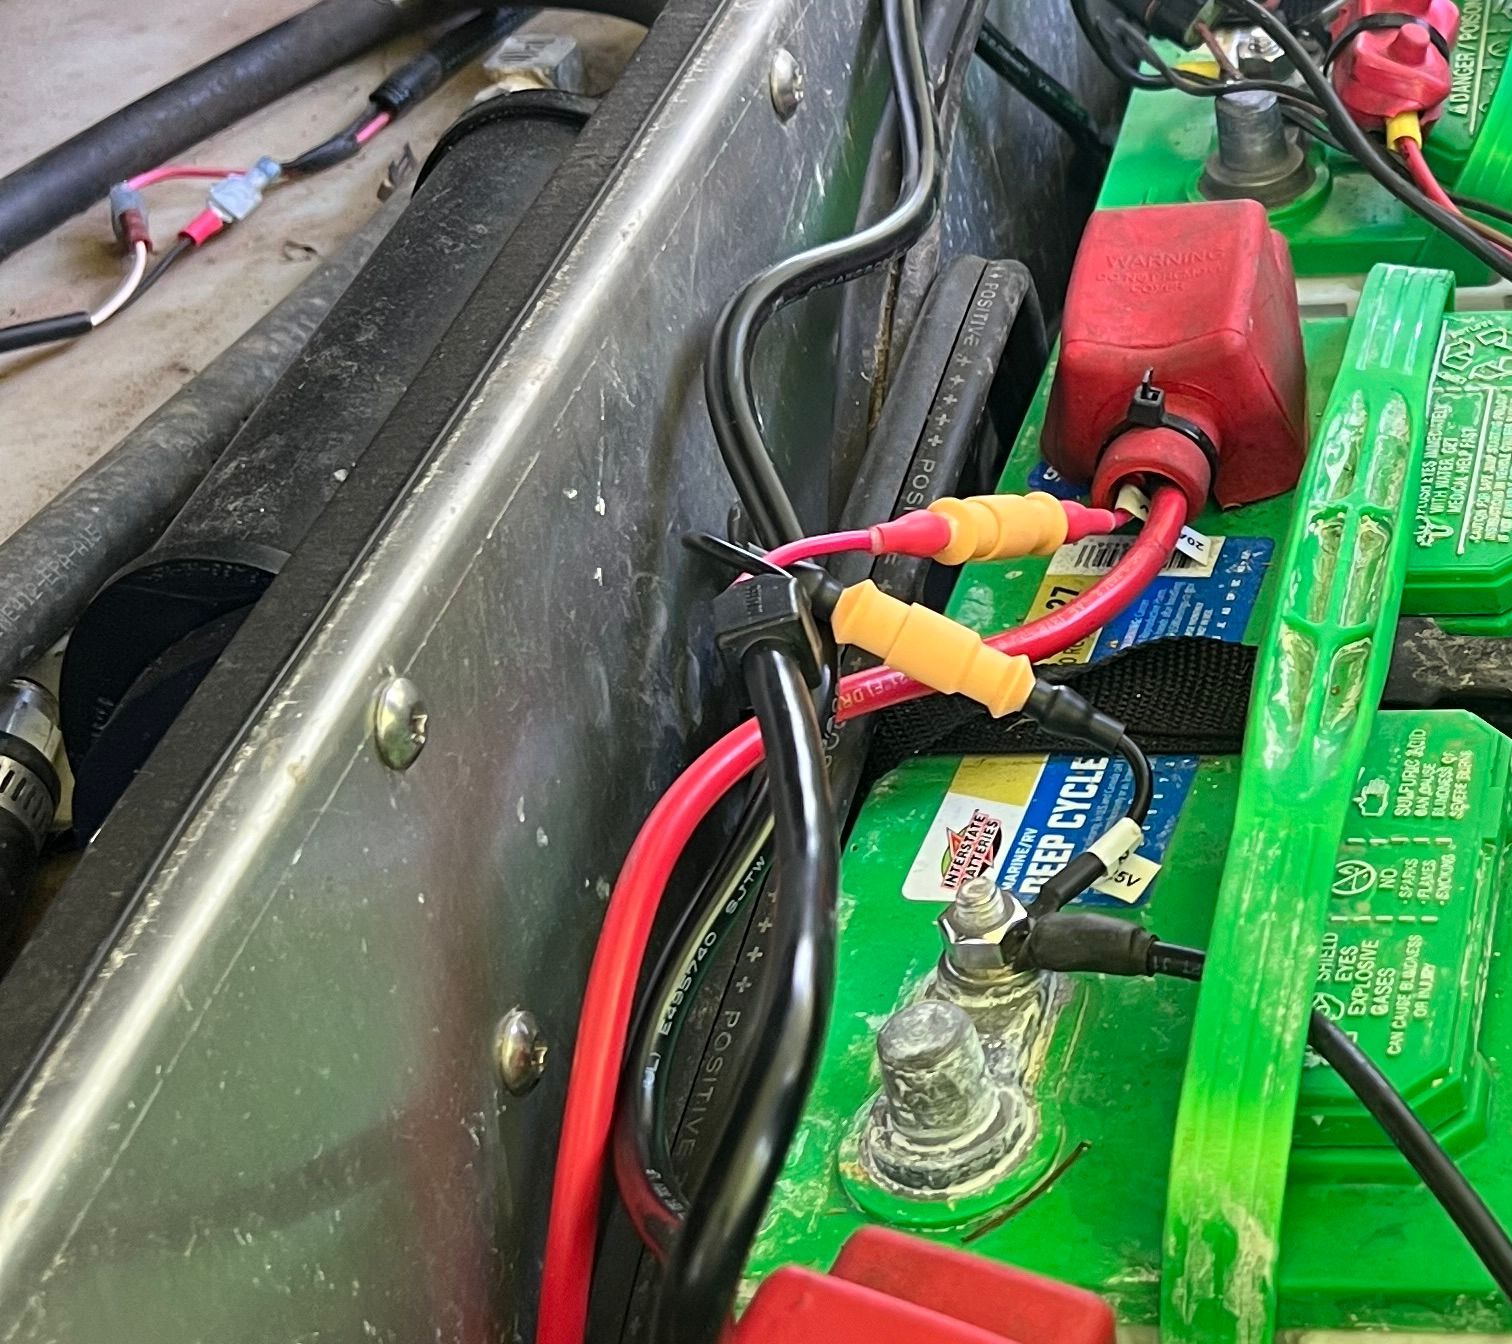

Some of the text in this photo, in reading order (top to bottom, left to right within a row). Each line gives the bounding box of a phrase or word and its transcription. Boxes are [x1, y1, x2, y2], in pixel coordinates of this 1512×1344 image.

[1450, 47, 1476, 104] DANGER
[1106, 249, 1225, 268] WARNING
[963, 282, 999, 346] POSITIVE
[1456, 450, 1473, 474] HELP
[1429, 489, 1447, 514] WITH
[1447, 474, 1469, 514] MEDICAL
[1394, 728, 1427, 817] SULFURIC ACID
[1019, 834, 1075, 894] DEEP
[1047, 757, 1110, 829] CYCLE
[1413, 791, 1429, 817] CAN
[944, 815, 985, 888] INTERSTATE
[1001, 827, 1038, 890] MARINE/RV
[1379, 868, 1398, 889] NO
[659, 931, 717, 1036] E495740
[725, 855, 766, 915] SJTW
[1317, 932, 1338, 982] SHIELD
[1335, 944, 1358, 981] EYES
[1347, 939, 1380, 1016] EXPLOSIVE
[1369, 967, 1396, 1016] GASES
[1386, 1030, 1402, 1056] CAN
[678, 1010, 741, 1157] POSITIVE
